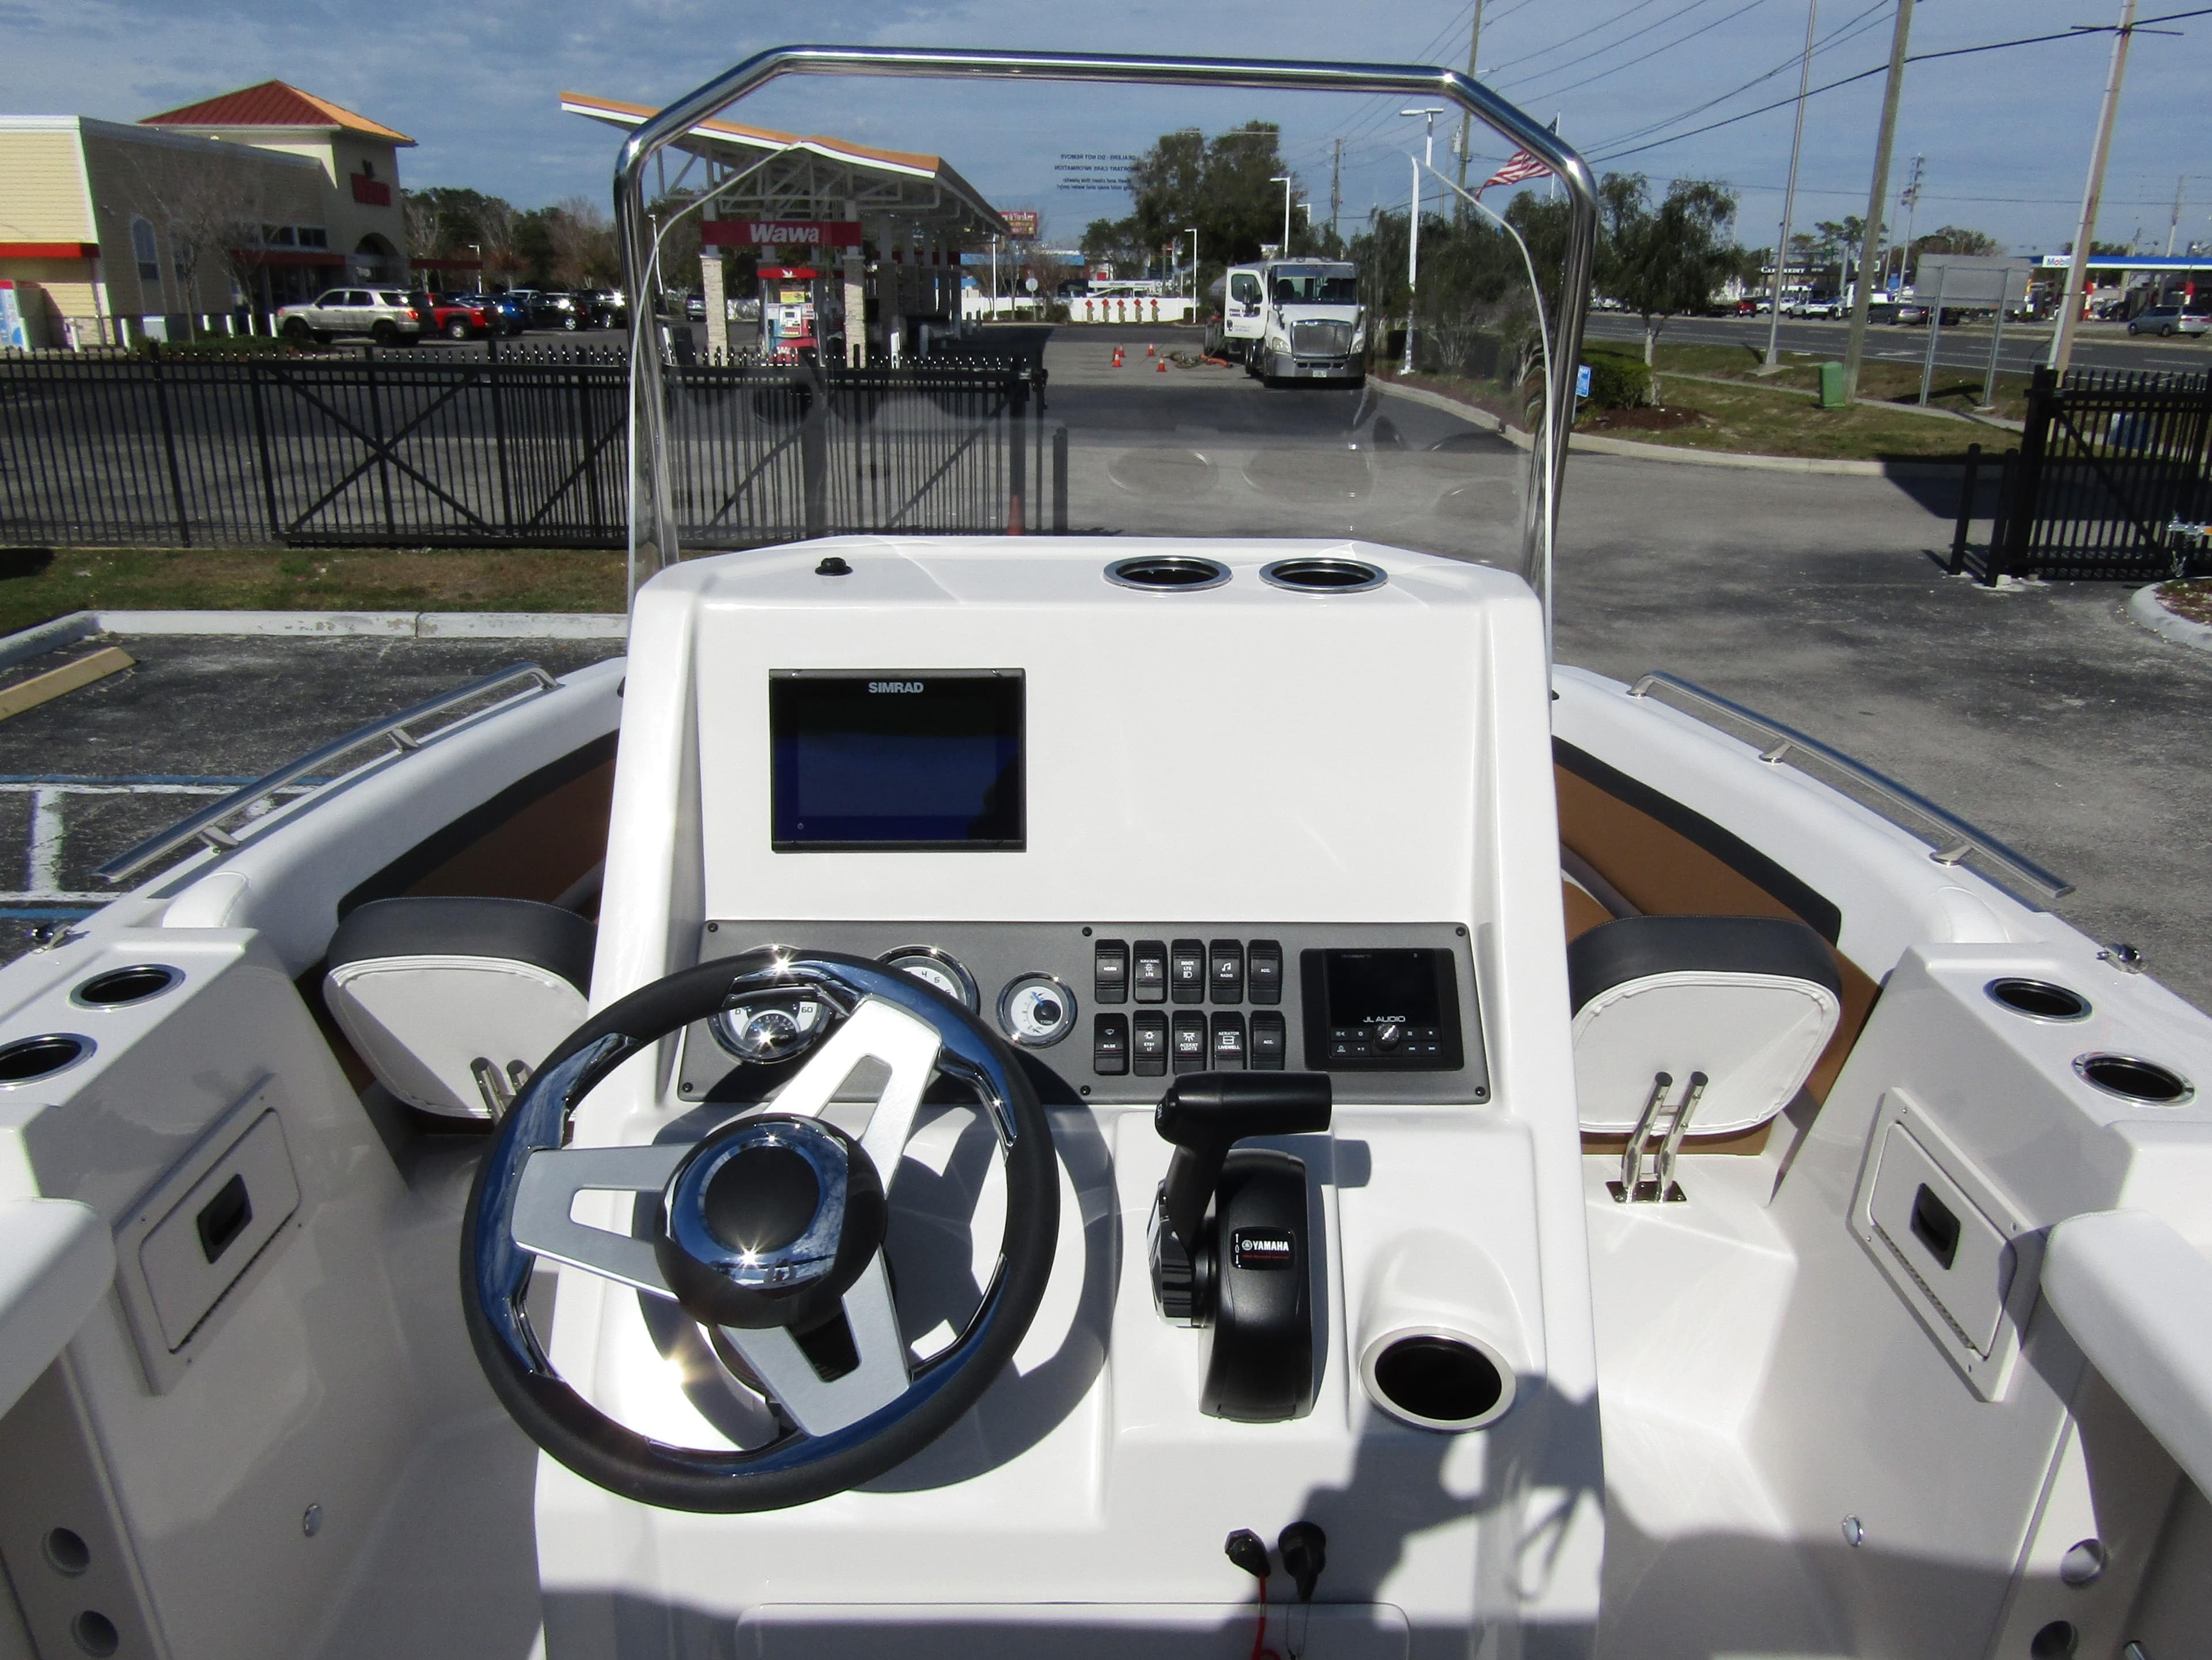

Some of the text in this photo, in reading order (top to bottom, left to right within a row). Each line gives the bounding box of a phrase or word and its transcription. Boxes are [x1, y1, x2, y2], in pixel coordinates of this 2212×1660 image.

[750, 223, 820, 243] Wawa
[868, 682, 924, 693] SIMRAD
[1252, 1241, 1289, 1251] YAMAHA
